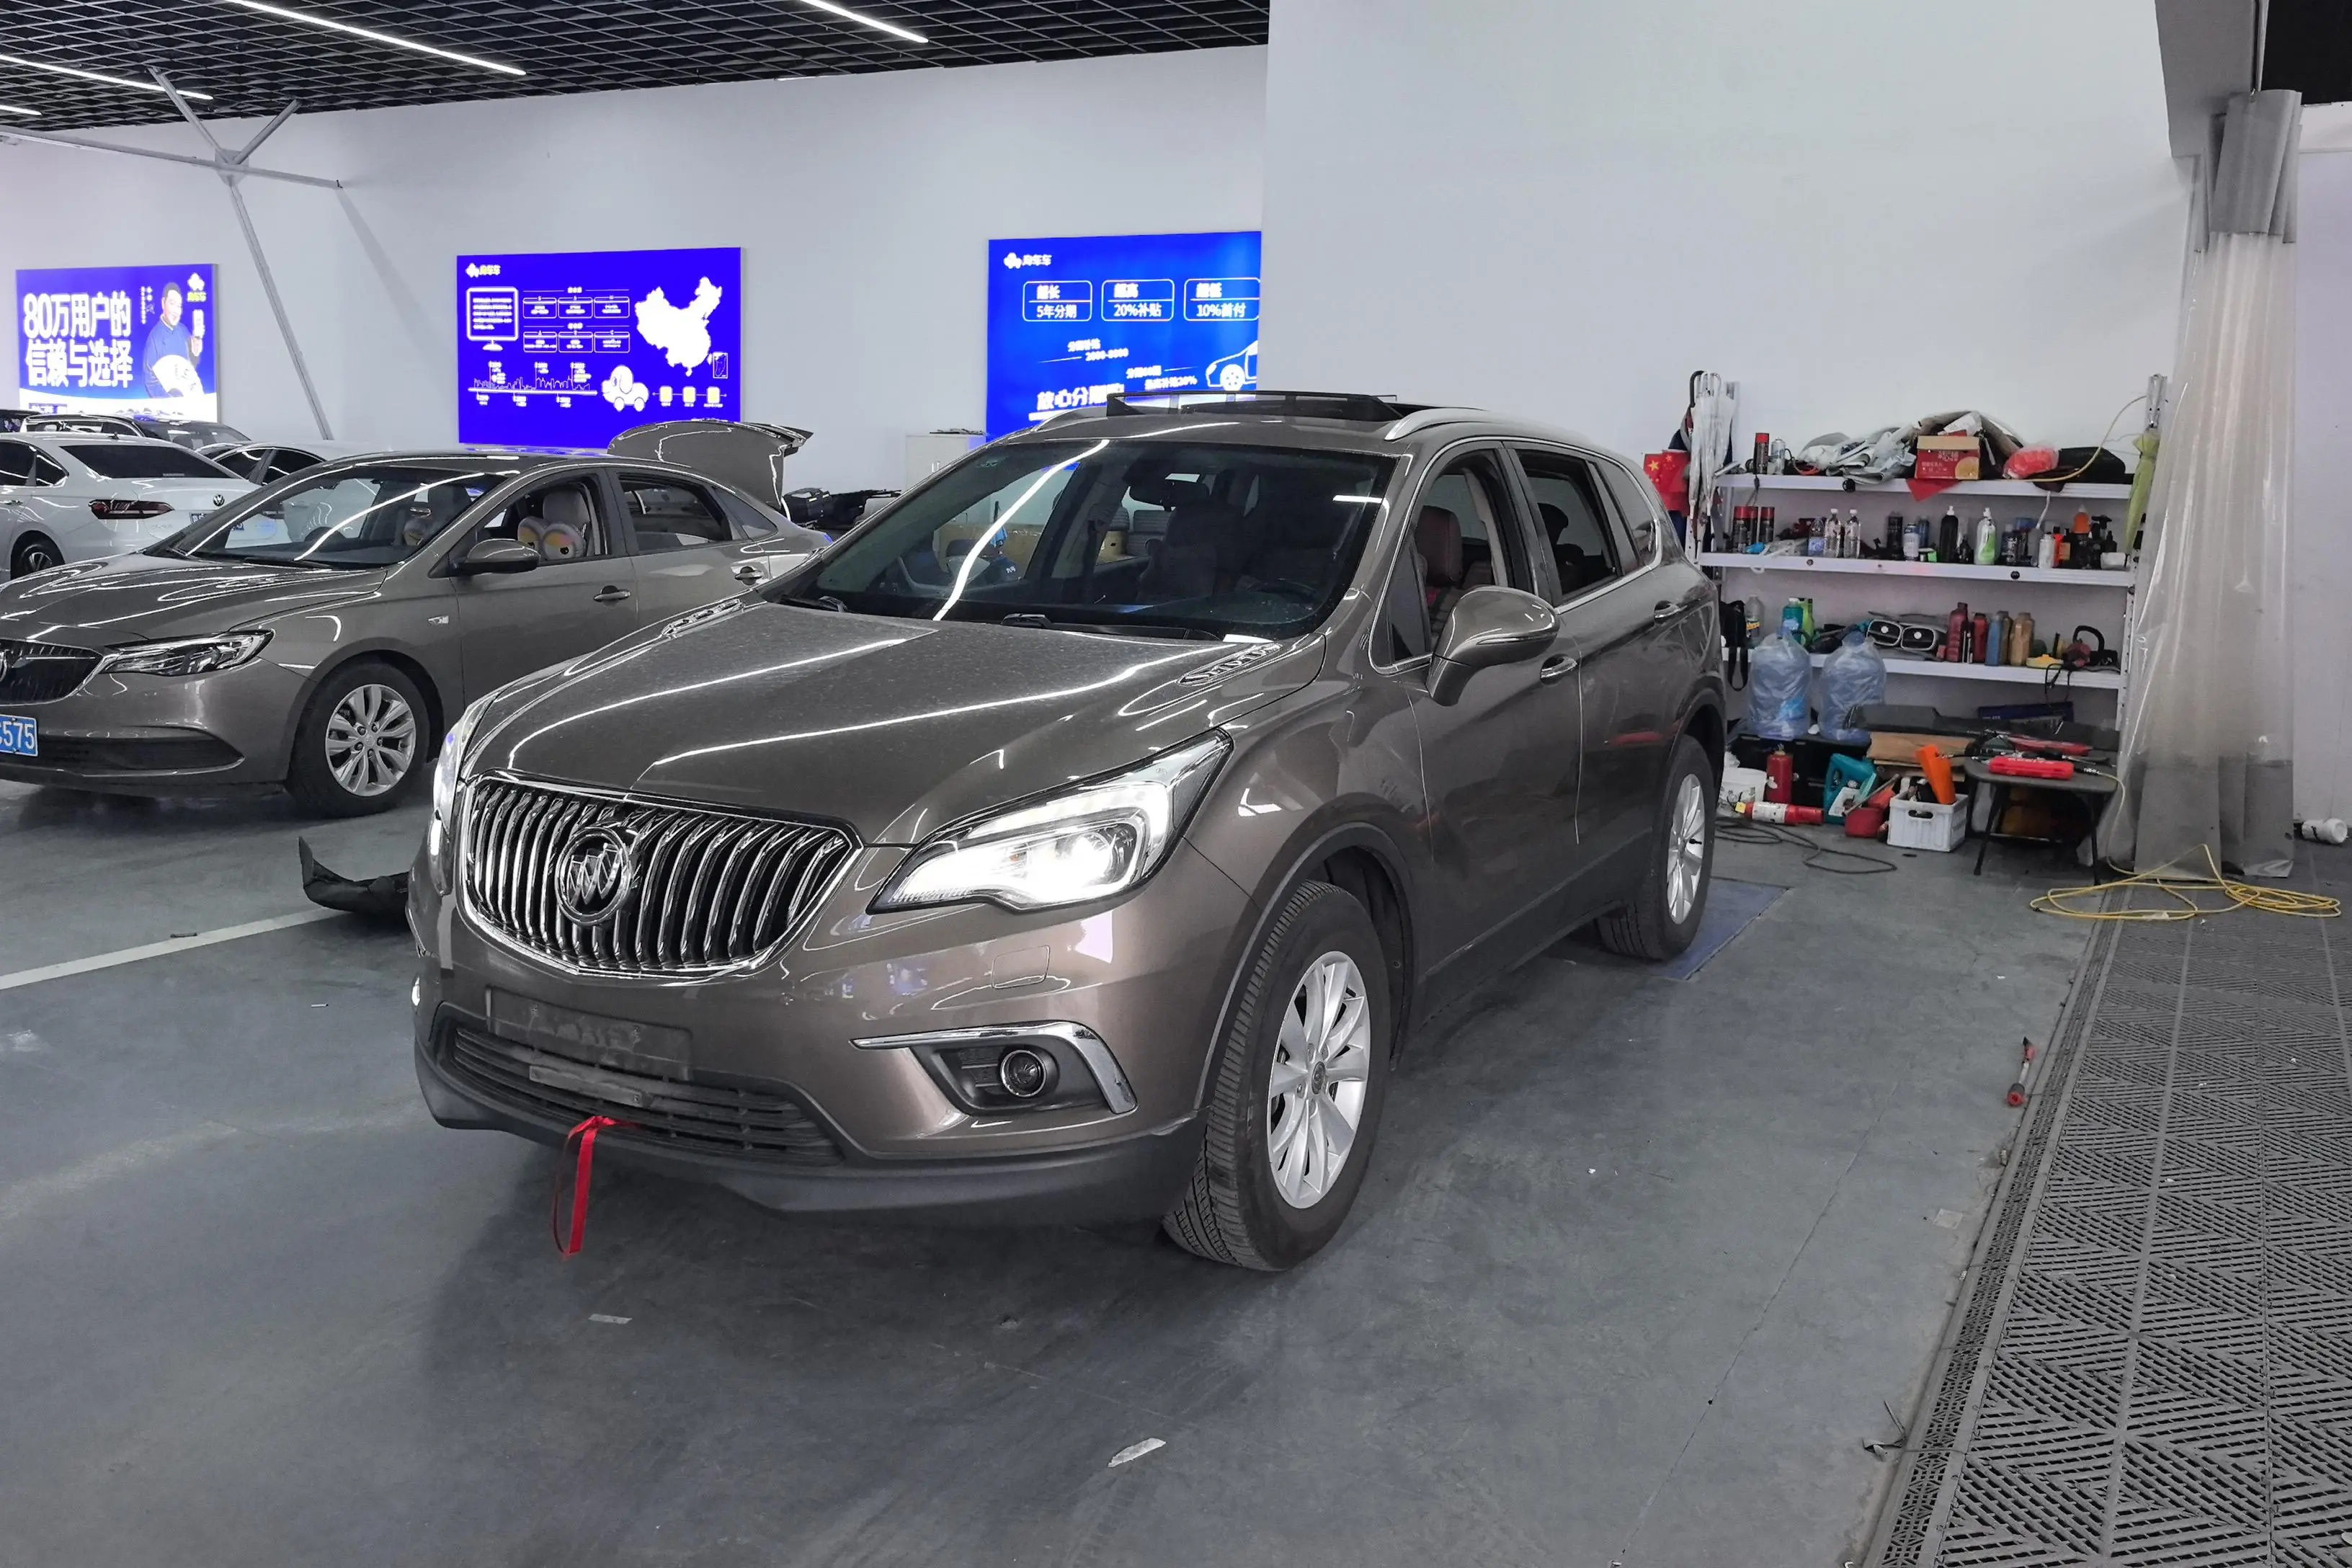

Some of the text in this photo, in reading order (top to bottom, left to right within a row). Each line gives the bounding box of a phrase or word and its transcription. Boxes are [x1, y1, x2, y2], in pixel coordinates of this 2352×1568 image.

[23, 290, 132, 339] 80万用户的
[1036, 304, 1077, 318] 5年分期
[1113, 303, 1162, 317] 20%补贴
[25, 338, 134, 388] 信赖与选择
[0, 721, 35, 749] 575
